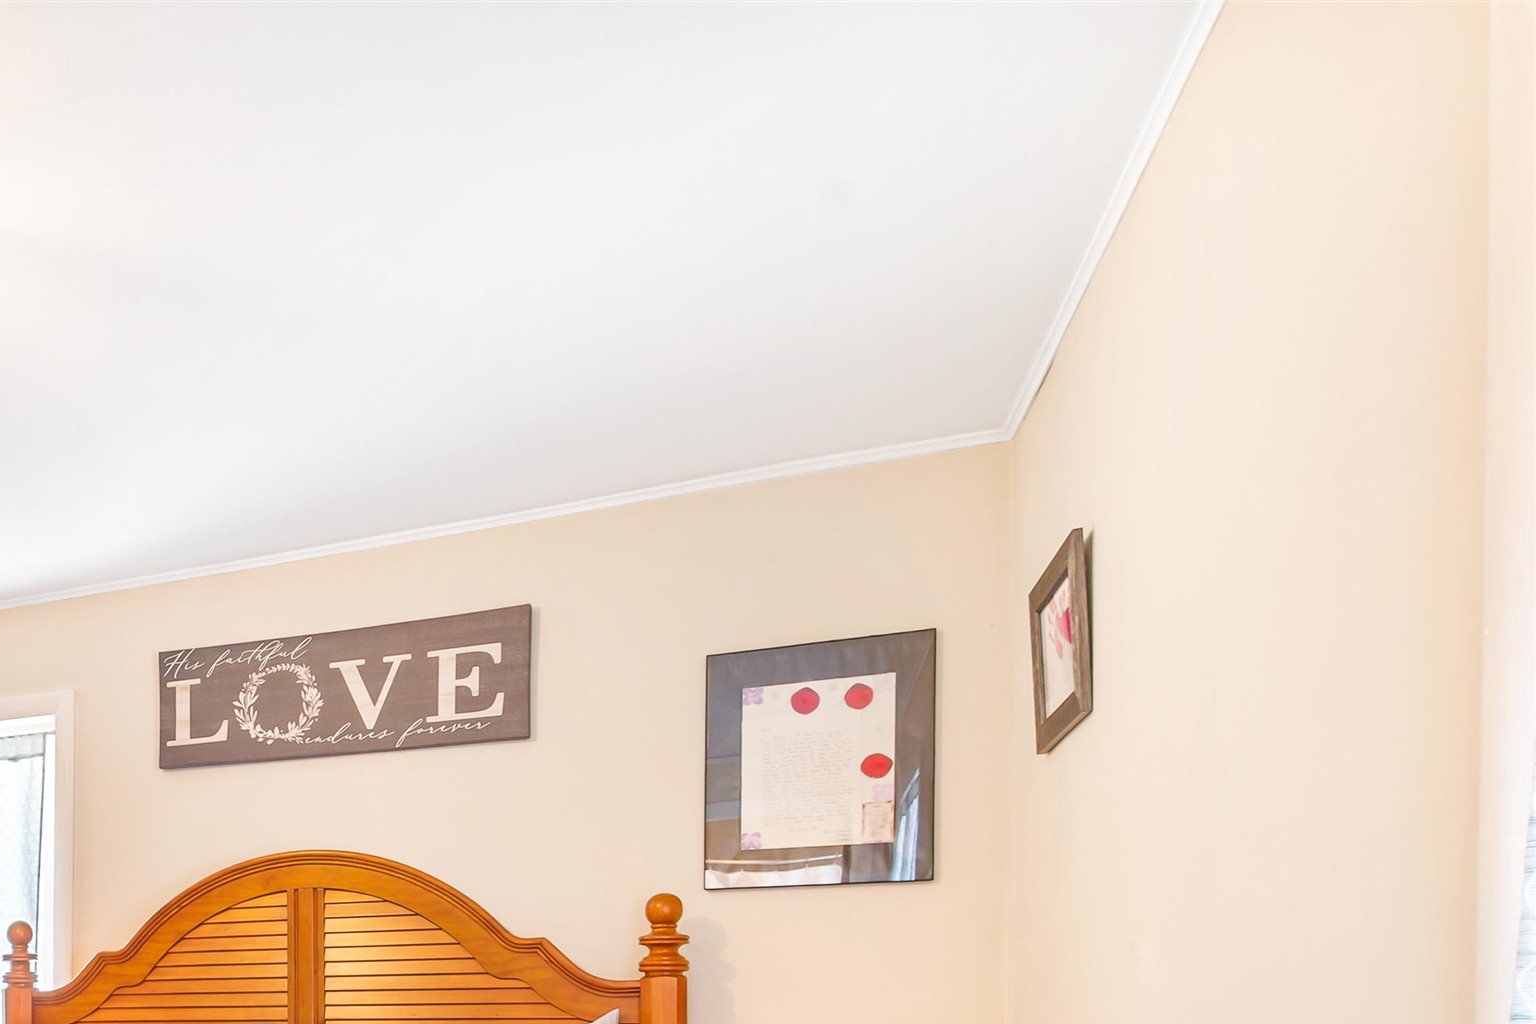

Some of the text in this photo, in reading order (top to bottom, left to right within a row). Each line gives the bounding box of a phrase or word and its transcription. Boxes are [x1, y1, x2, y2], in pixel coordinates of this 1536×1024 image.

[163, 636, 313, 679] His faithful
[166, 642, 506, 748] LOVE
[304, 718, 491, 748] endures forever
